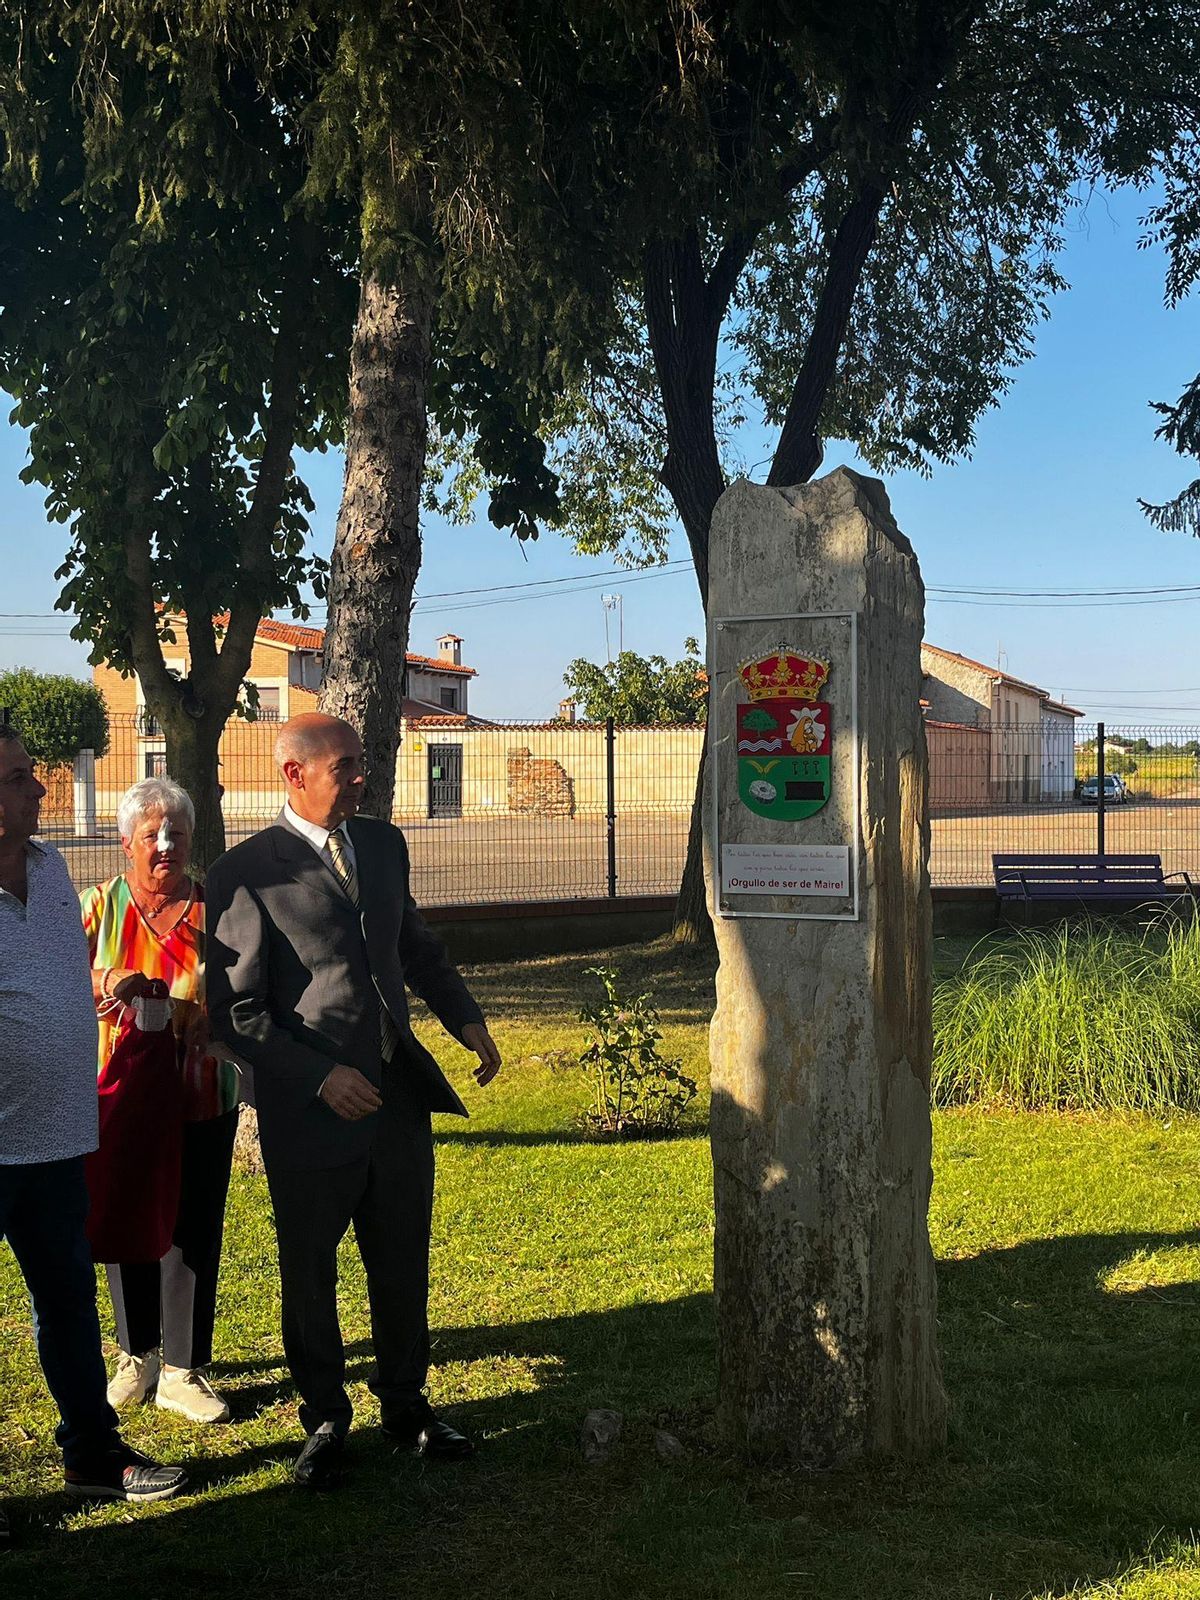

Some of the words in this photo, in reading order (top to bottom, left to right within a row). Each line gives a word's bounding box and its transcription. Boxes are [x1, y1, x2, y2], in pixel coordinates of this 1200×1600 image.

[728, 877, 766, 889] ¡Orgullo
[768, 879, 780, 888] de
[782, 880, 798, 888] ser
[800, 879, 812, 889] de
[814, 879, 844, 889] Maire!
